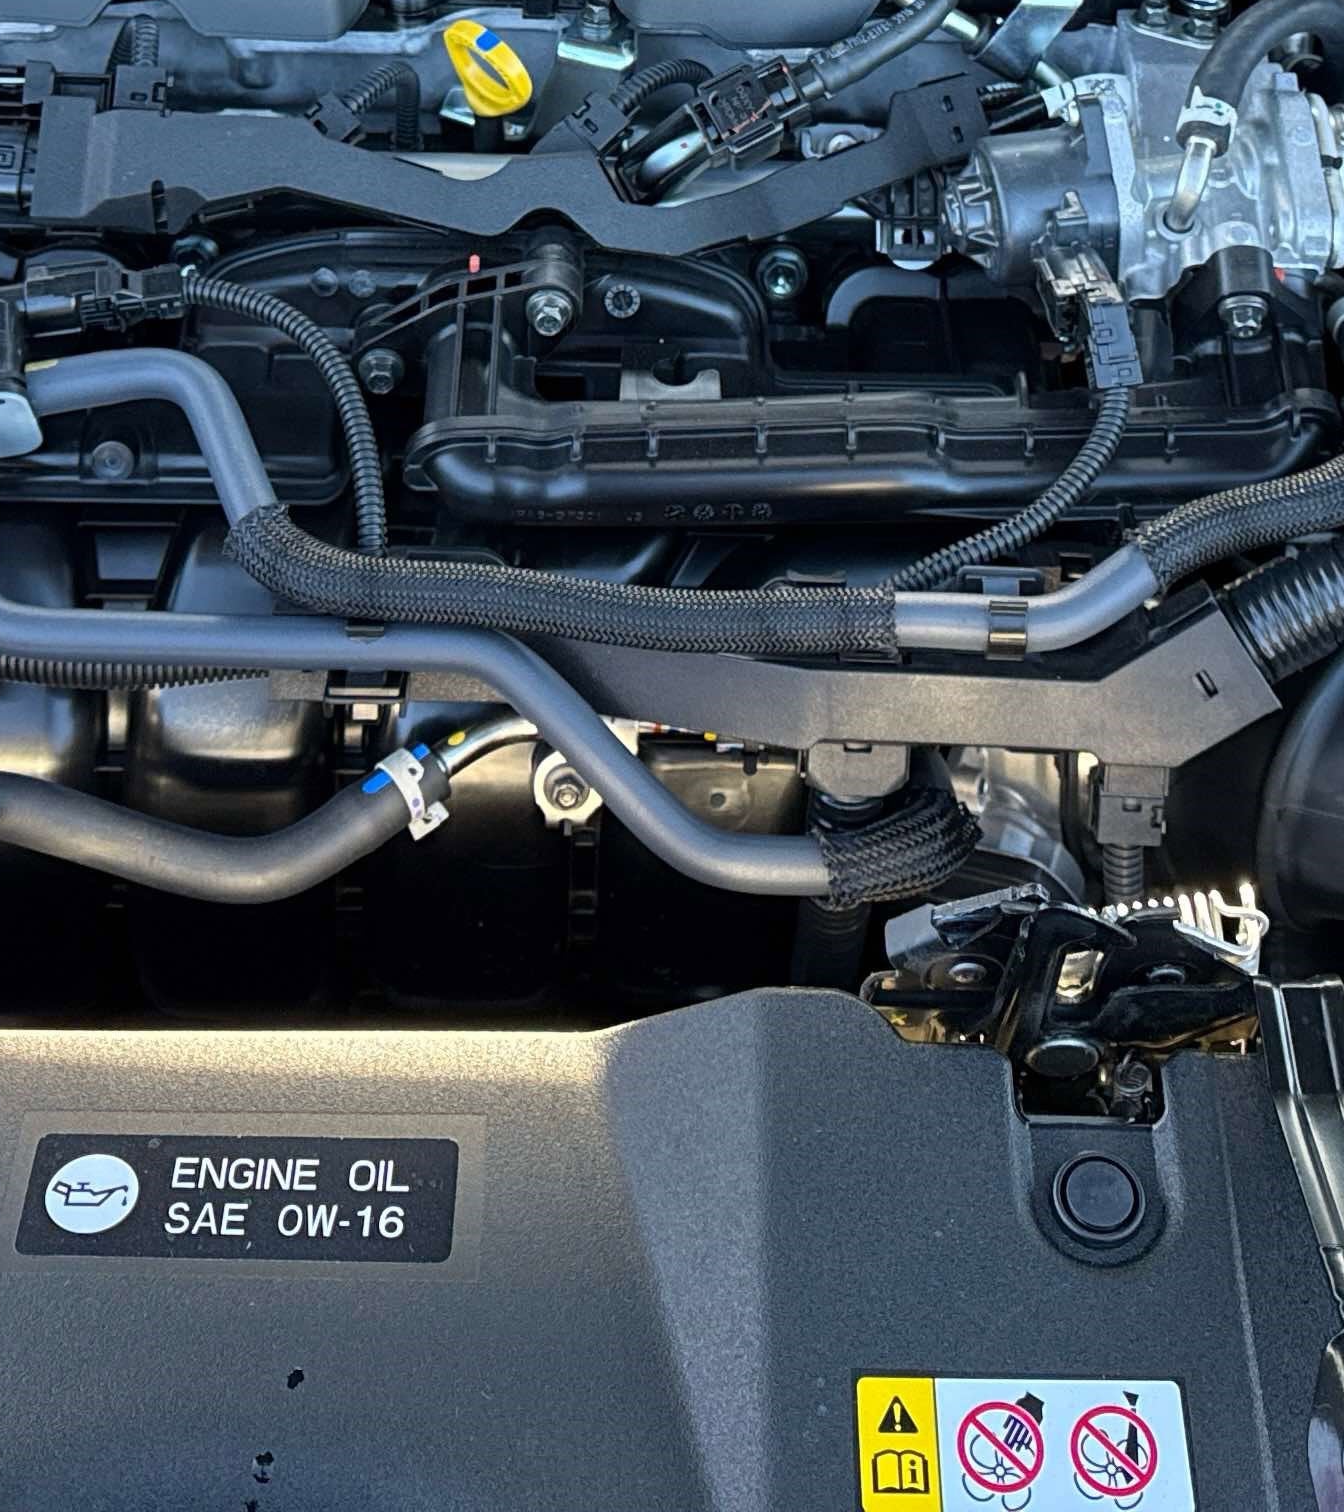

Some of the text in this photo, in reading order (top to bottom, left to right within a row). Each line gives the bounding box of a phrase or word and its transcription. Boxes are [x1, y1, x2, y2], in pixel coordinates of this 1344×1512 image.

[171, 1156, 410, 1194] ENGINE OIL
[163, 1201, 405, 1239] SAE 0W-16
